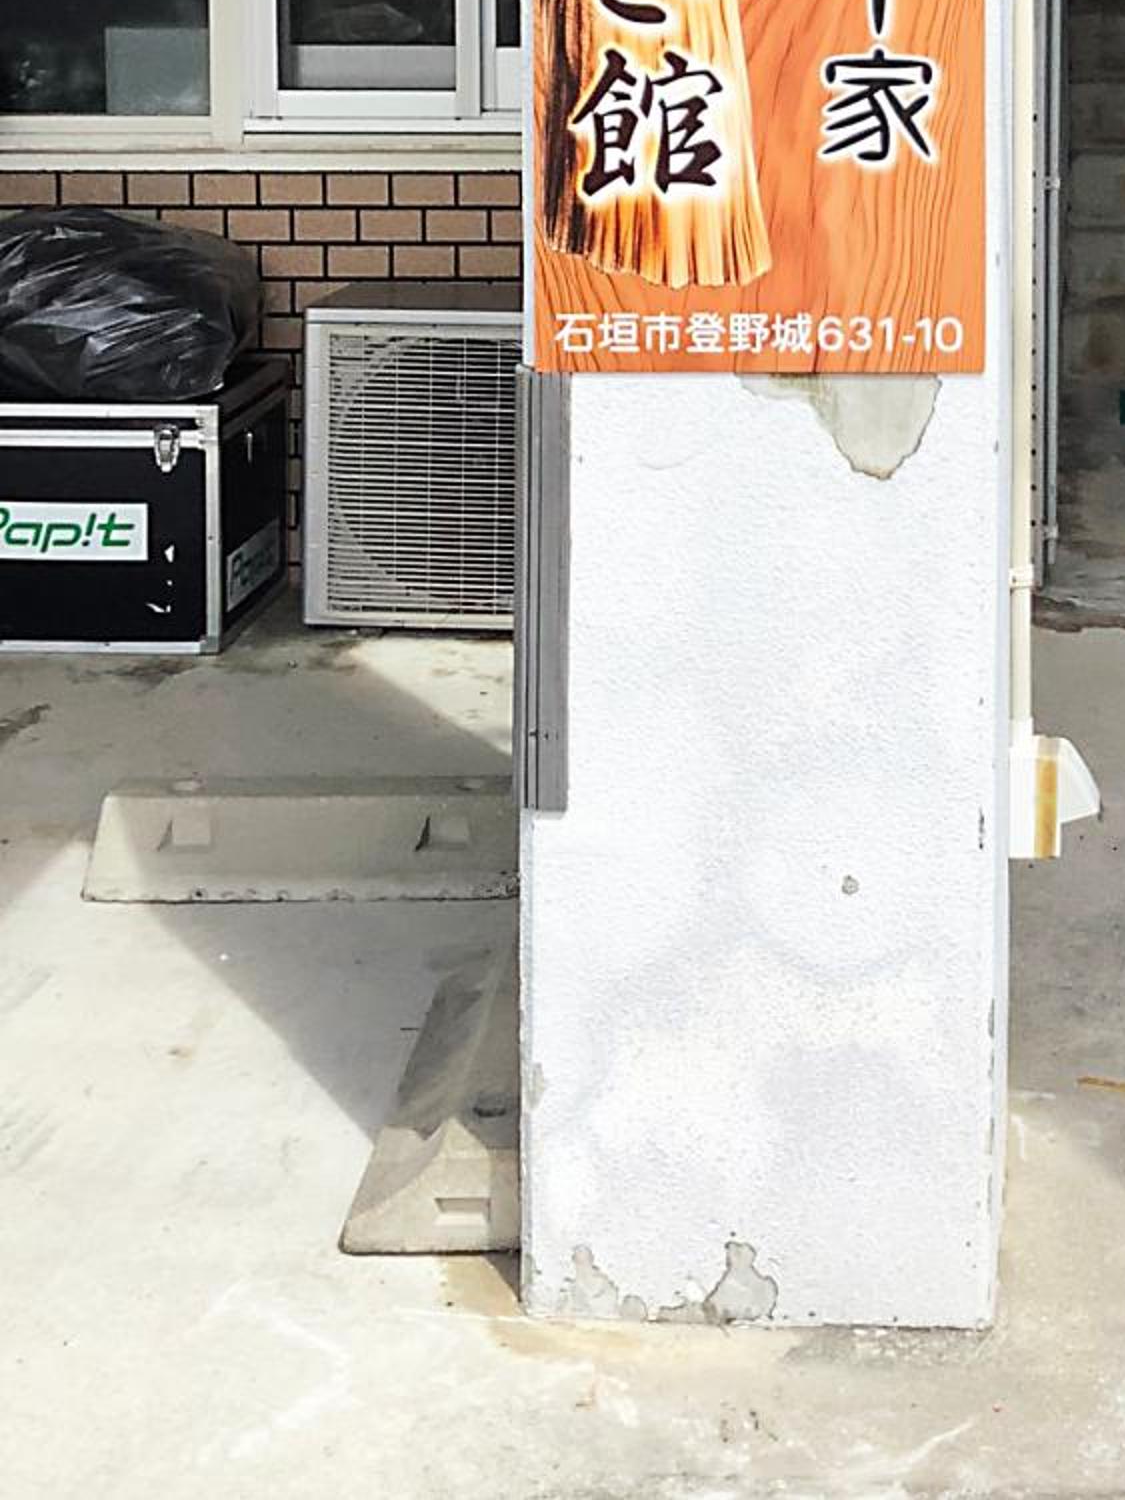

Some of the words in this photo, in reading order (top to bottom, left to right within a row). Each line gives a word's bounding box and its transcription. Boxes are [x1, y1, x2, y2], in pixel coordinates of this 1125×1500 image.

[553, 312, 964, 355] 石垣市登野城631-10
